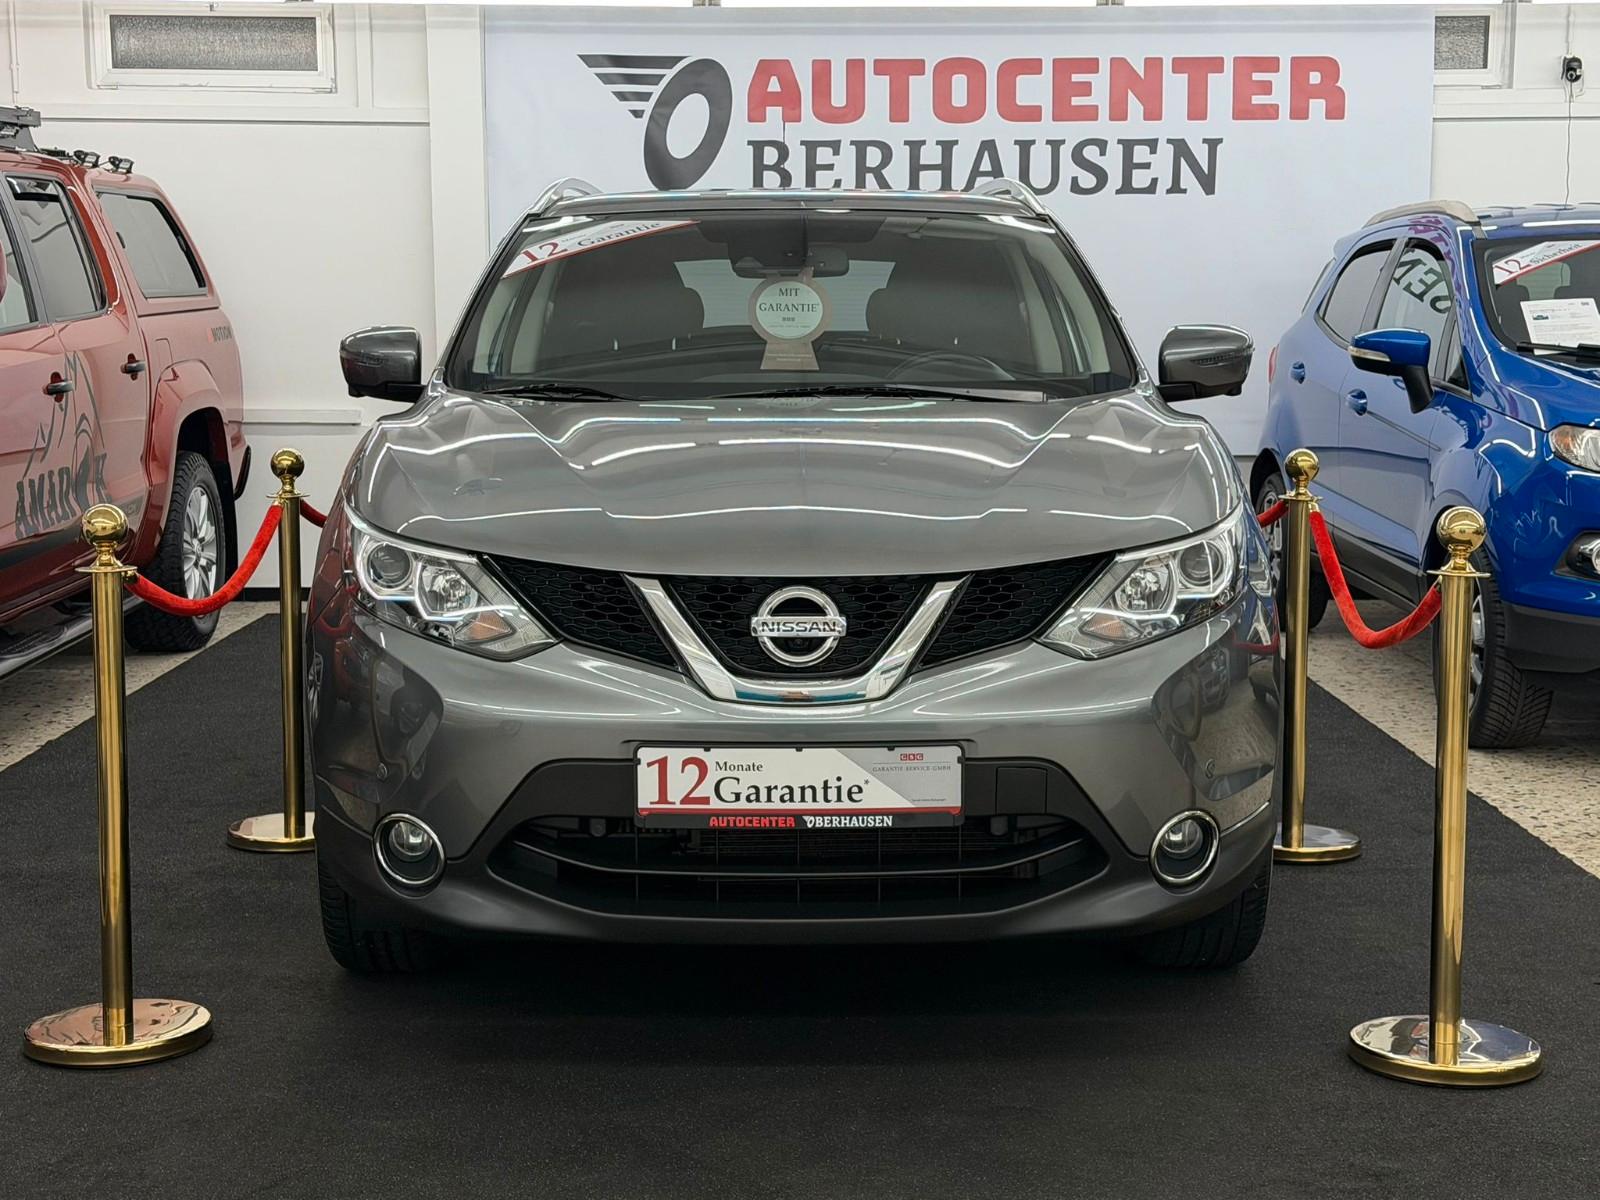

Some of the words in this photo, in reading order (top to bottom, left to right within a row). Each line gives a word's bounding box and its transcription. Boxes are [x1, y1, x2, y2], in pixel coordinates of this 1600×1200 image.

[747, 55, 1346, 123] AUTOCENTER
[522, 241, 568, 265] 12
[578, 223, 661, 247] Garantie
[778, 287, 801, 297] MIT
[761, 621, 837, 633] NISSAN
[646, 755, 711, 806] 12
[714, 760, 764, 773] Monate
[709, 816, 796, 828] AUTOCENTER
